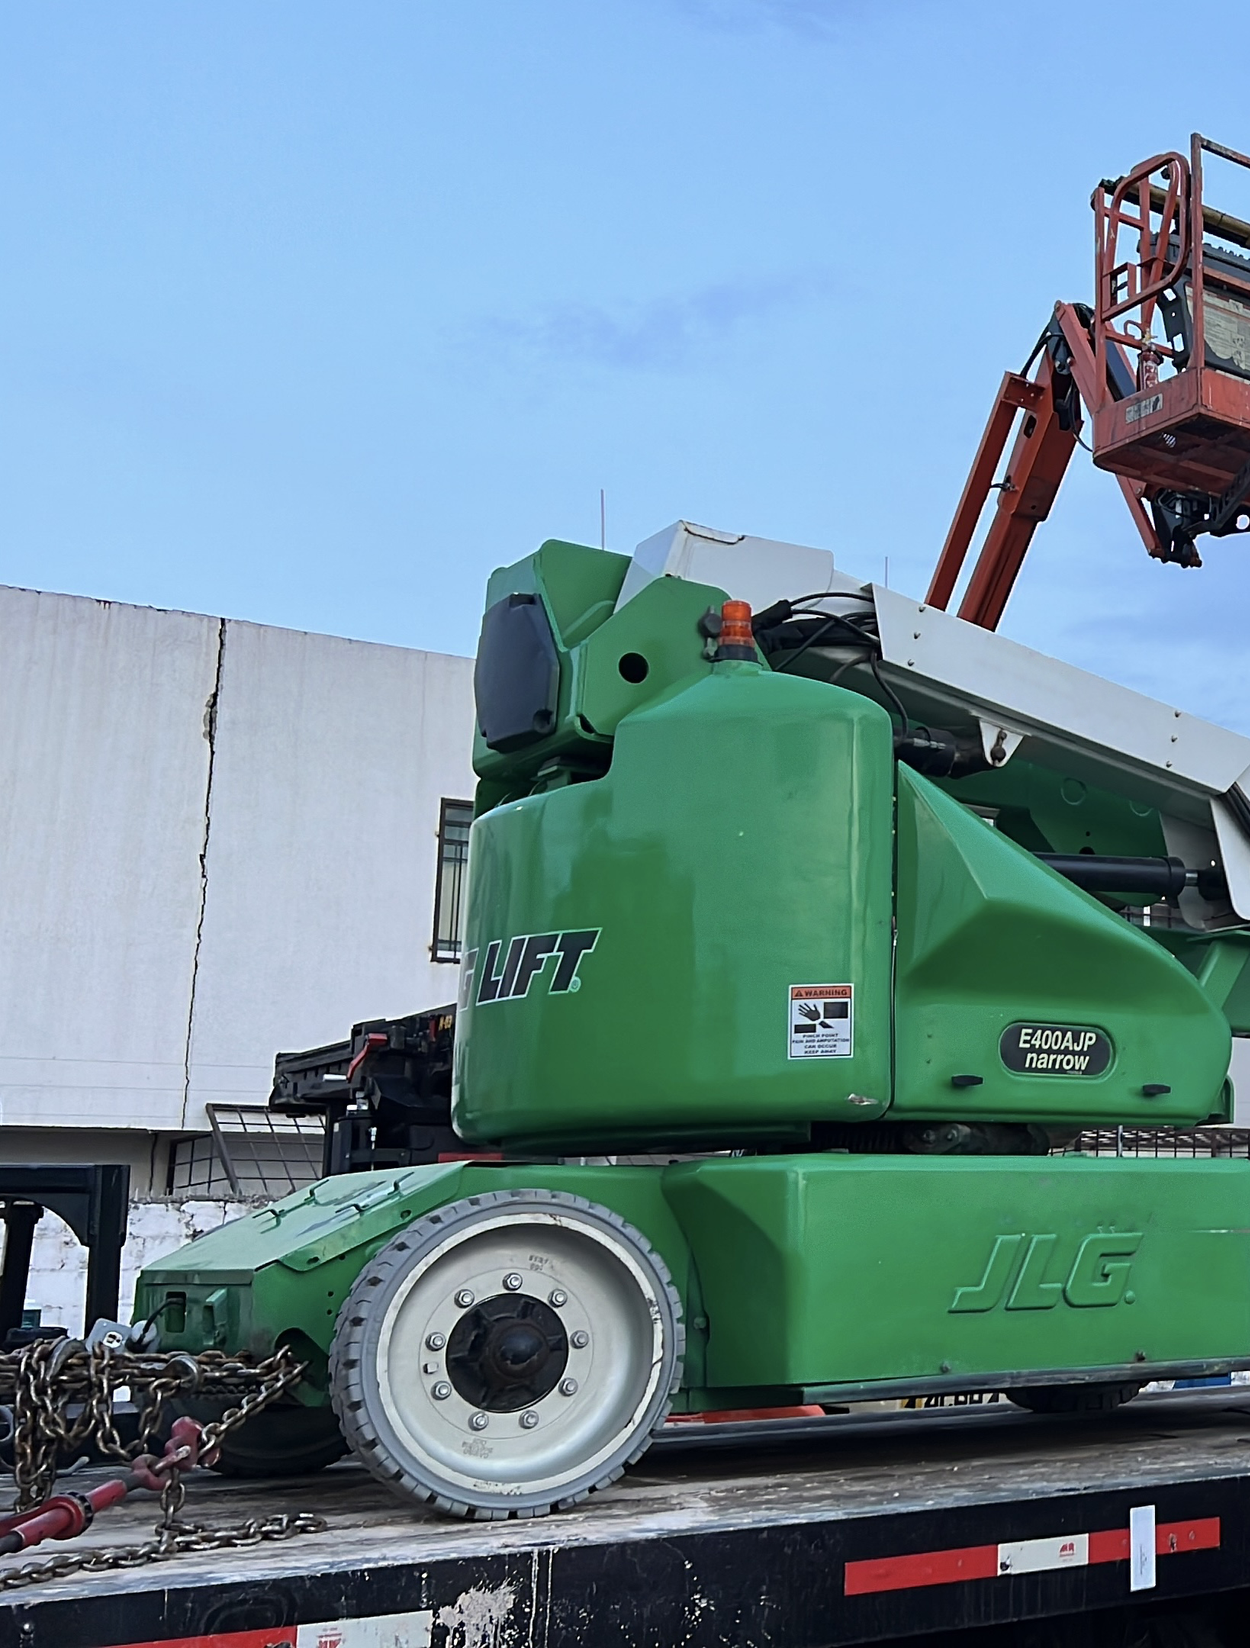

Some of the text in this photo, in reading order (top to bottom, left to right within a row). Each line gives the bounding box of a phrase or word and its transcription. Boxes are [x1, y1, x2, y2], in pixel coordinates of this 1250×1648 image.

[804, 989, 848, 997] WARNING
[1019, 1028, 1096, 1051] E400AJP
[1025, 1052, 1090, 1071] narrow
